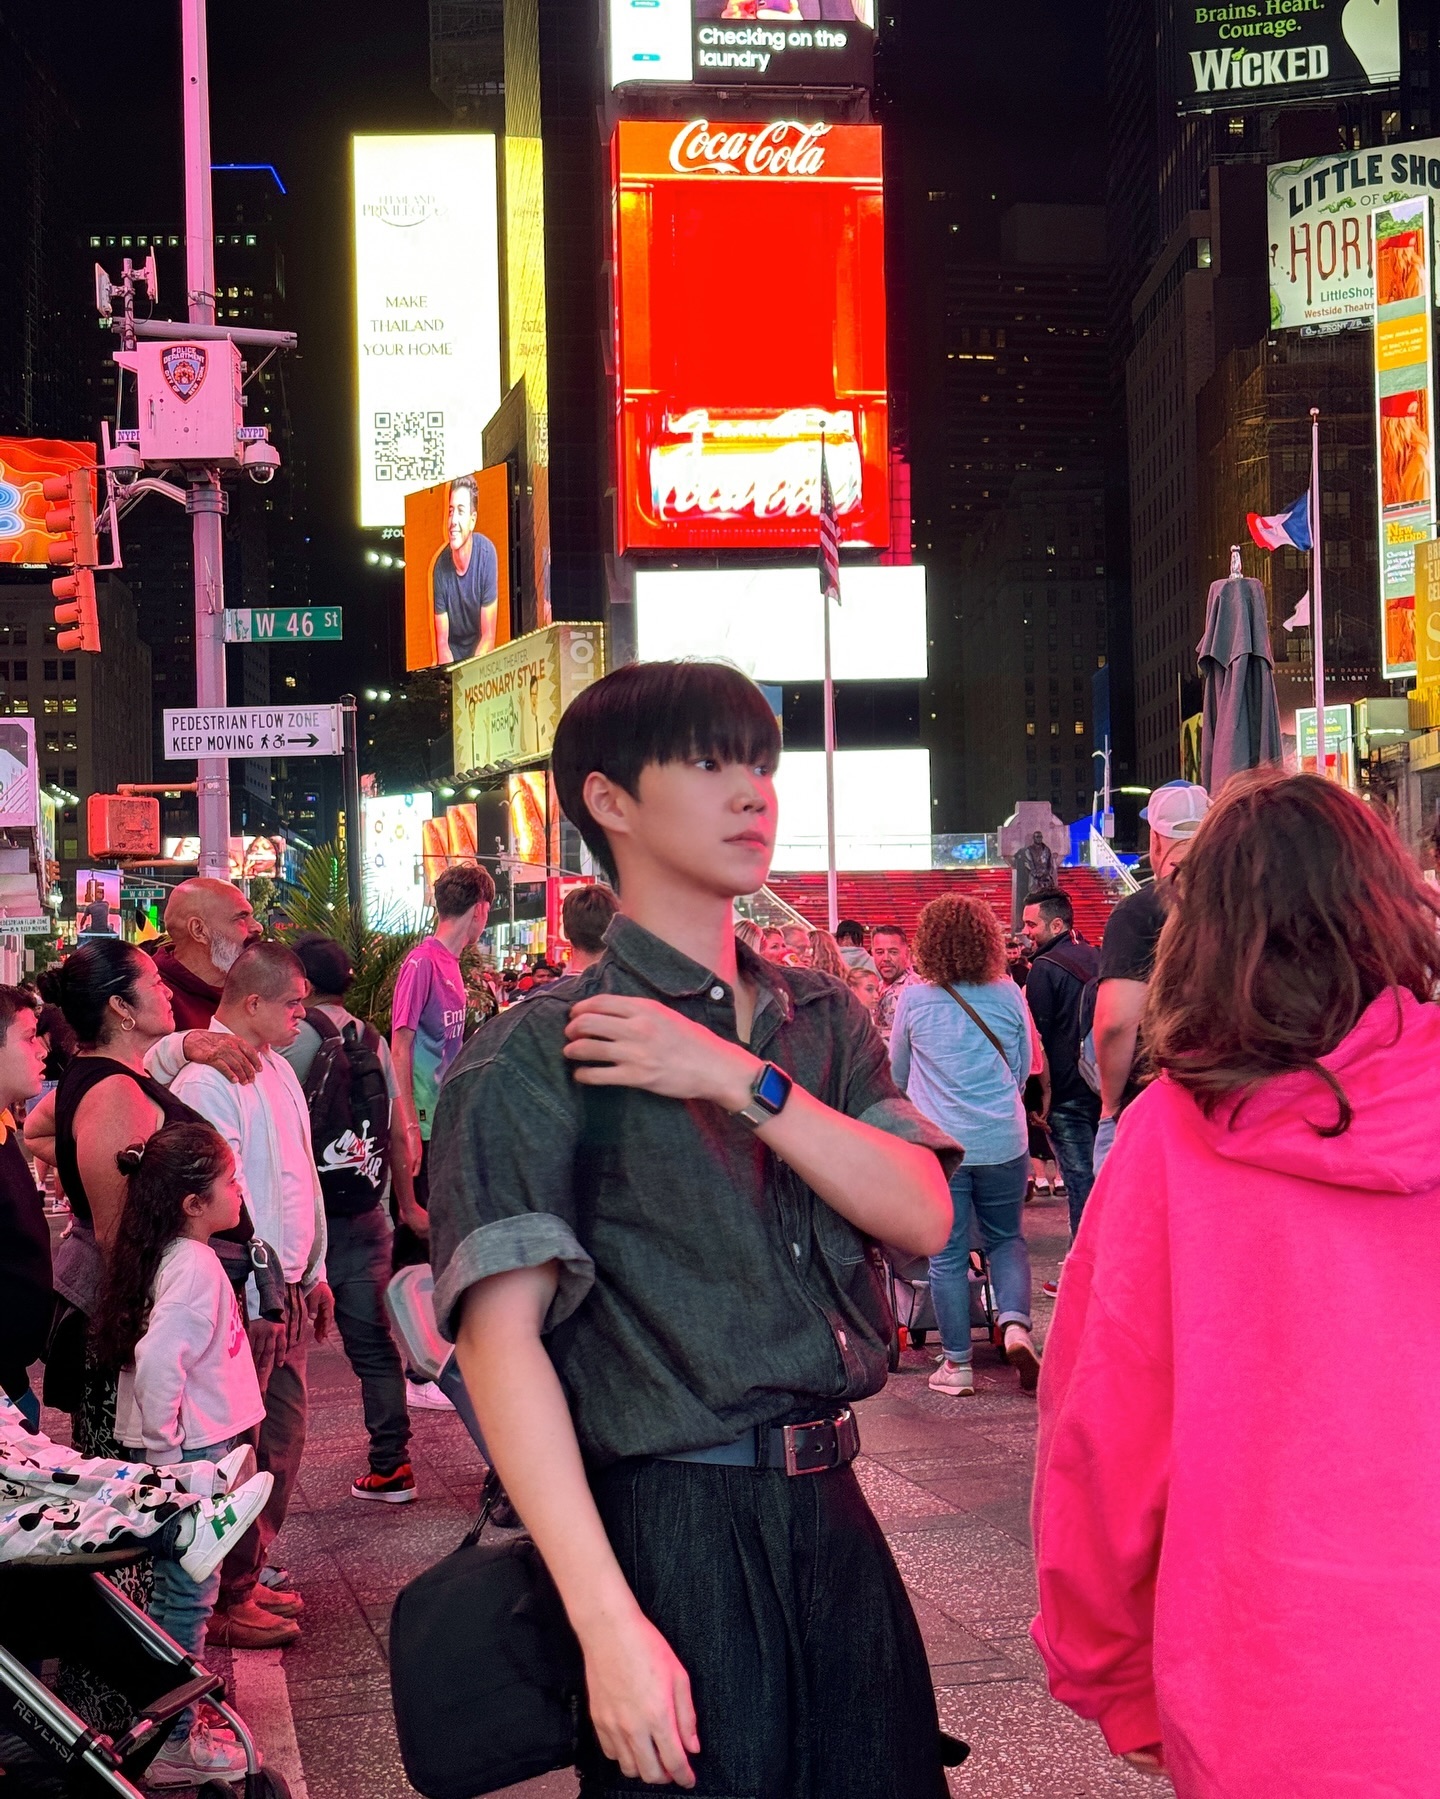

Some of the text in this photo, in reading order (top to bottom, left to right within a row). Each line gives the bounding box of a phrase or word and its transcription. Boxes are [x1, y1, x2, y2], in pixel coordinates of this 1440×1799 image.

[1195, 0, 1325, 24] Brains. Heart.
[1218, 18, 1301, 40] Courage.
[699, 28, 848, 49] Checking on the
[700, 50, 770, 72] laundry
[1289, 154, 1383, 219] LITTLE
[1360, 194, 1380, 206] OF
[386, 296, 428, 308] MAKE
[1304, 306, 1342, 319] Westside
[370, 319, 444, 332] THAILAND
[163, 353, 205, 364] DEPARTMENT
[363, 343, 453, 356] YOUR HOME
[164, 369, 174, 384] CITY
[240, 428, 265, 438] NYPD
[256, 611, 338, 637] W 46 St
[478, 649, 529, 679] MUSICAL THEATER
[464, 658, 546, 708] MISSIONARY STYLE
[172, 712, 320, 731] PEDESTRIAN FLOW ZONE
[173, 735, 254, 752] KEEP MOVING
